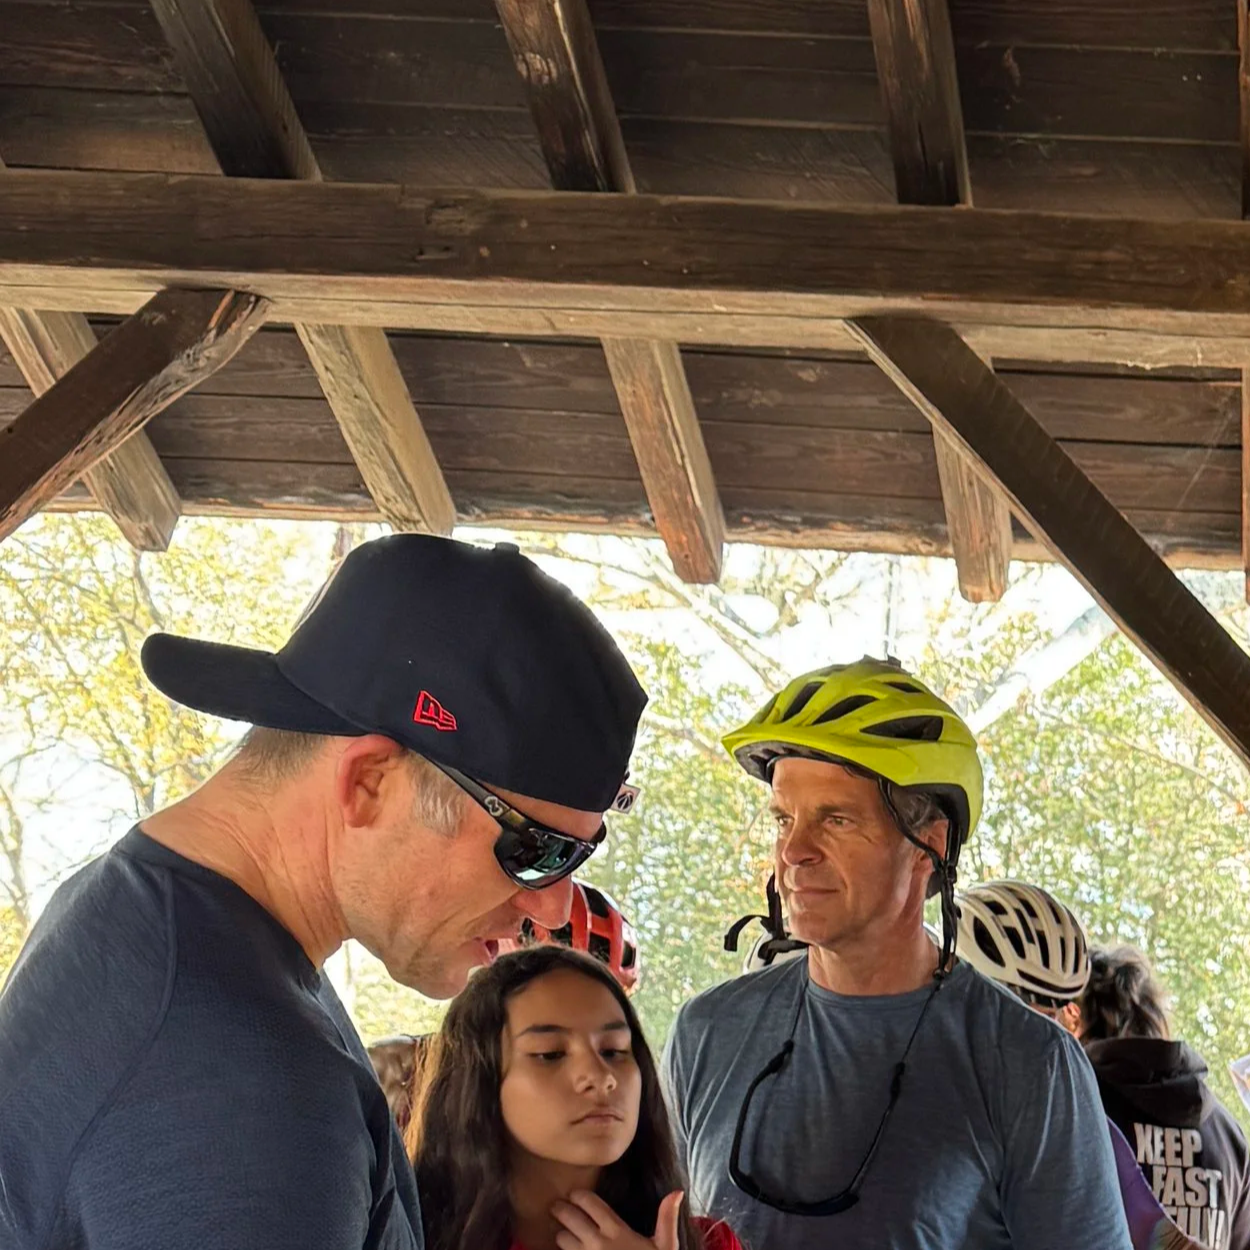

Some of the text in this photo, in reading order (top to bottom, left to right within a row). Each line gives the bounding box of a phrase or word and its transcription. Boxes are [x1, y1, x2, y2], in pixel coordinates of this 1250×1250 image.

[1133, 1122, 1202, 1167] KEEP
[1151, 1166, 1222, 1209] FAST
[1166, 1205, 1225, 1250] UN!
